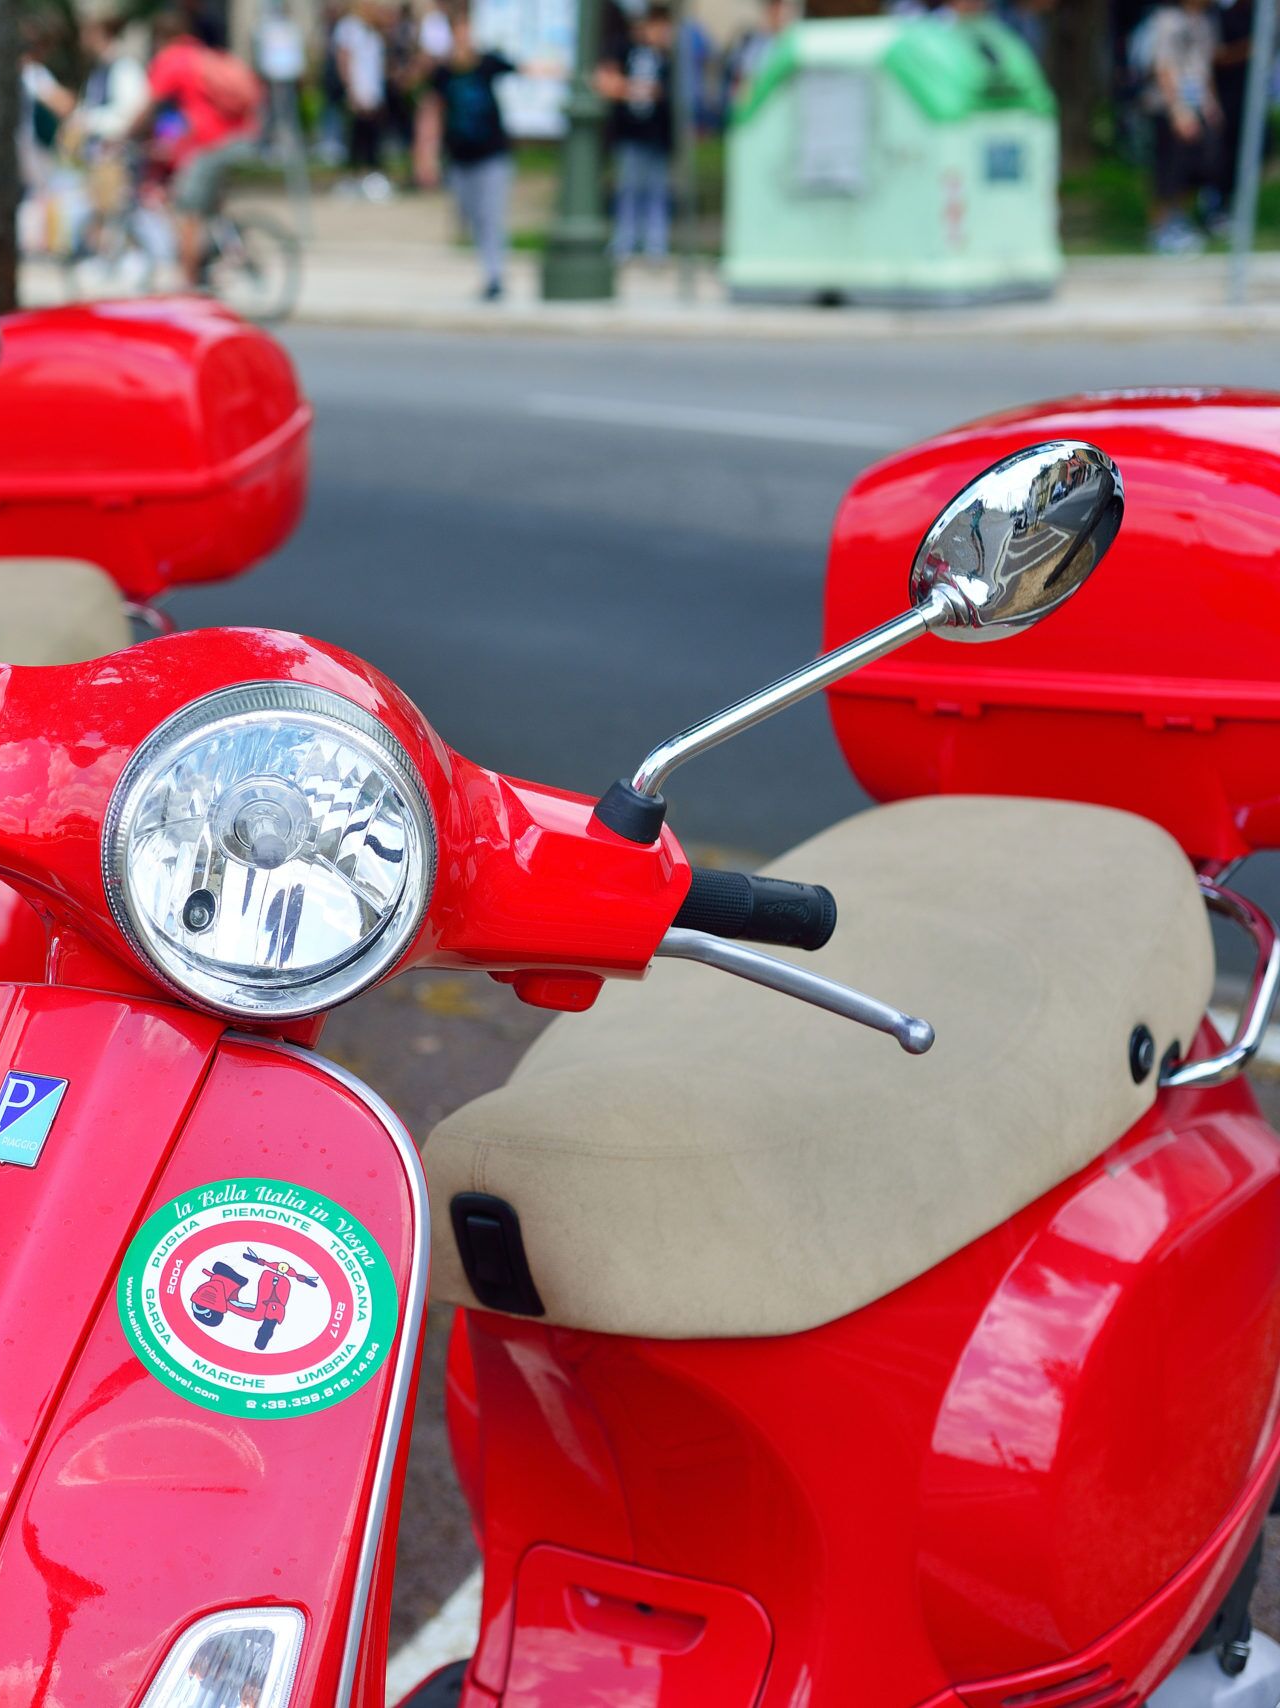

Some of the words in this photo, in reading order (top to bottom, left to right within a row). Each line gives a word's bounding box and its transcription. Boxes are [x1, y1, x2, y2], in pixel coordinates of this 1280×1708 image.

[1, 1135, 39, 1151] PIAGGIO
[174, 1202, 194, 1219] la
[198, 1184, 250, 1208] Bella
[255, 1186, 309, 1211] Italia
[309, 1202, 330, 1223] in
[335, 1217, 377, 1269] Vespa
[222, 1207, 311, 1232] PIEMONTE
[151, 1220, 200, 1268] PUGLIA
[166, 1258, 184, 1295] 2004
[329, 1240, 368, 1322] TOSCANA
[145, 1288, 171, 1345] GARDA
[329, 1301, 346, 1339] 2017
[126, 1276, 220, 1402] www.kalitumbatravel.com
[192, 1359, 265, 1389] MARCHE
[296, 1343, 356, 1384] UMBRIA
